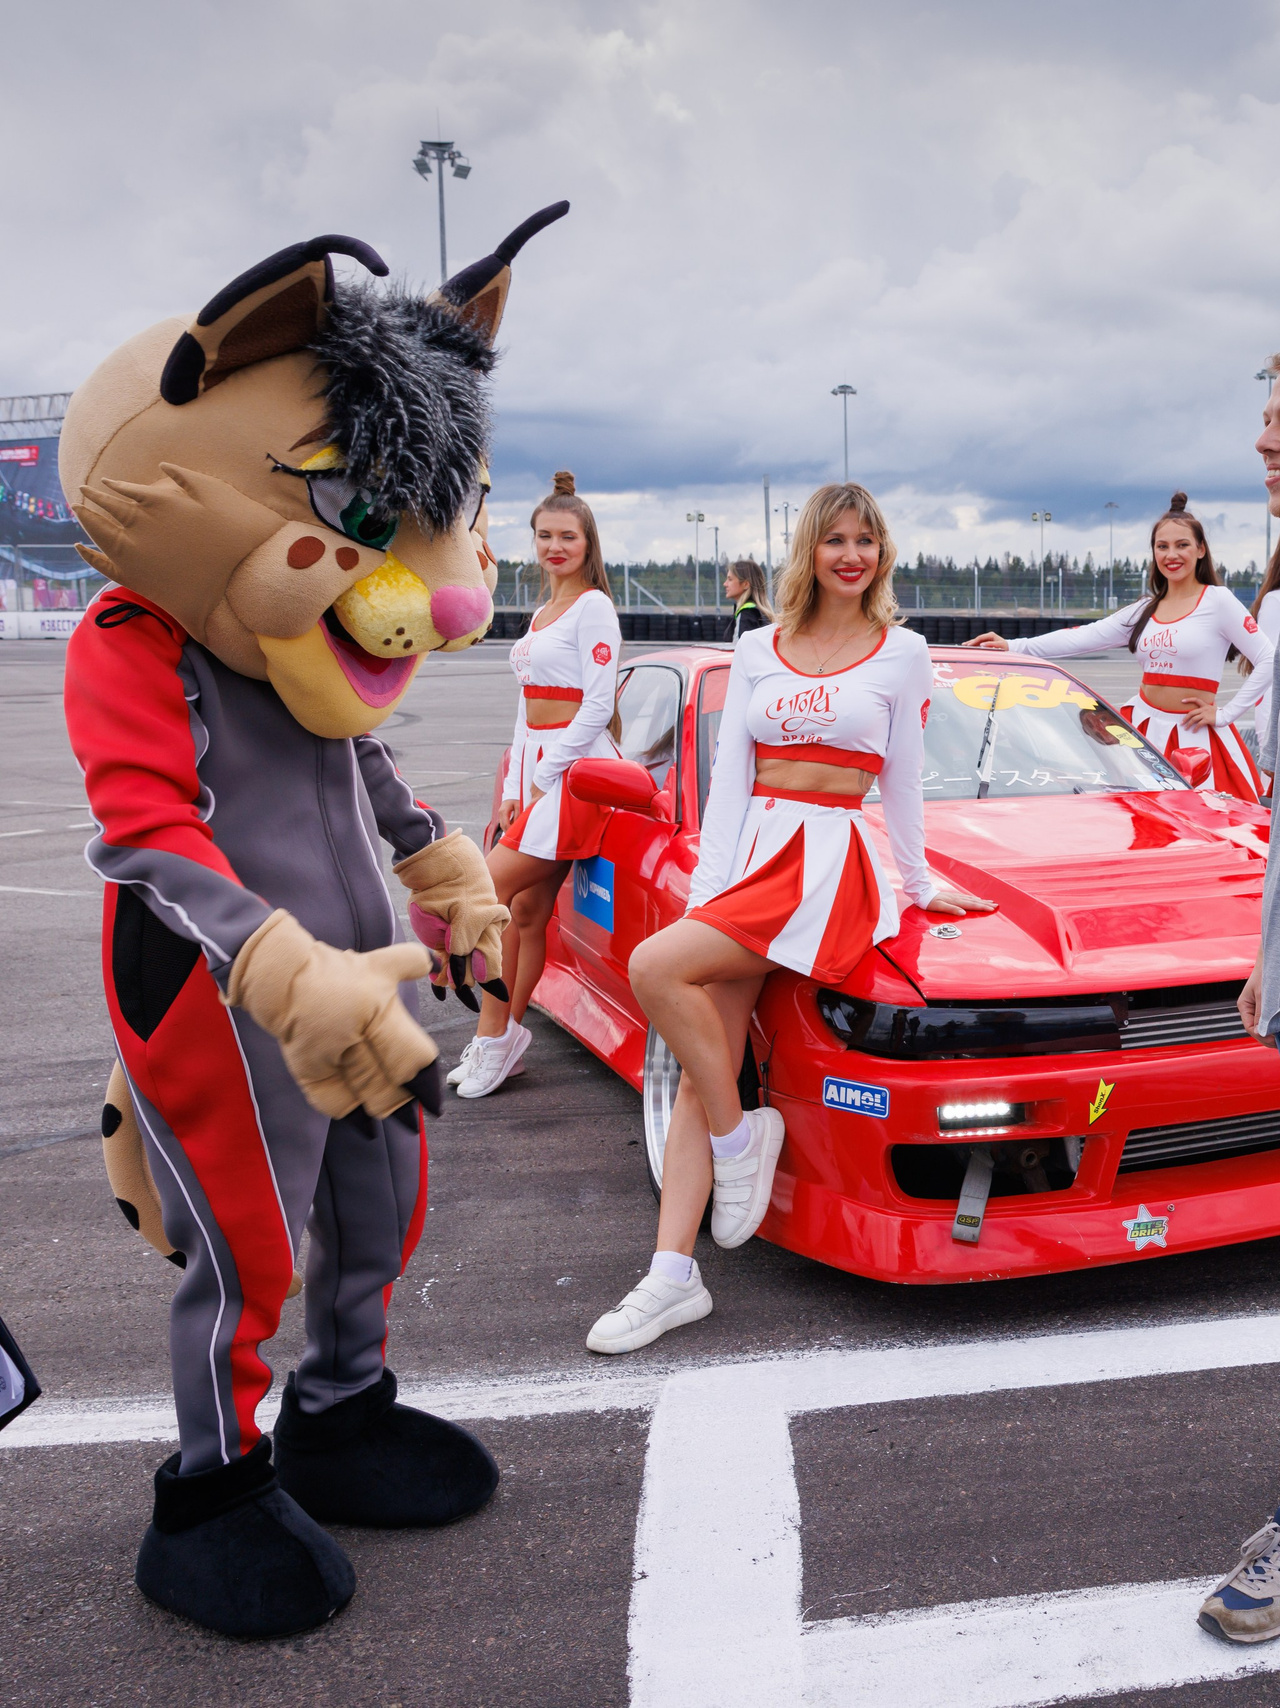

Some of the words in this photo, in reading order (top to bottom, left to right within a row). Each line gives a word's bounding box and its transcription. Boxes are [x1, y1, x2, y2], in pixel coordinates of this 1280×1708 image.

[41, 619, 82, 632] ИЗВЕСТИ
[953, 675, 1099, 710] 664
[1134, 1220, 1163, 1231] LET'S
[1131, 1227, 1164, 1238] DRIFT
